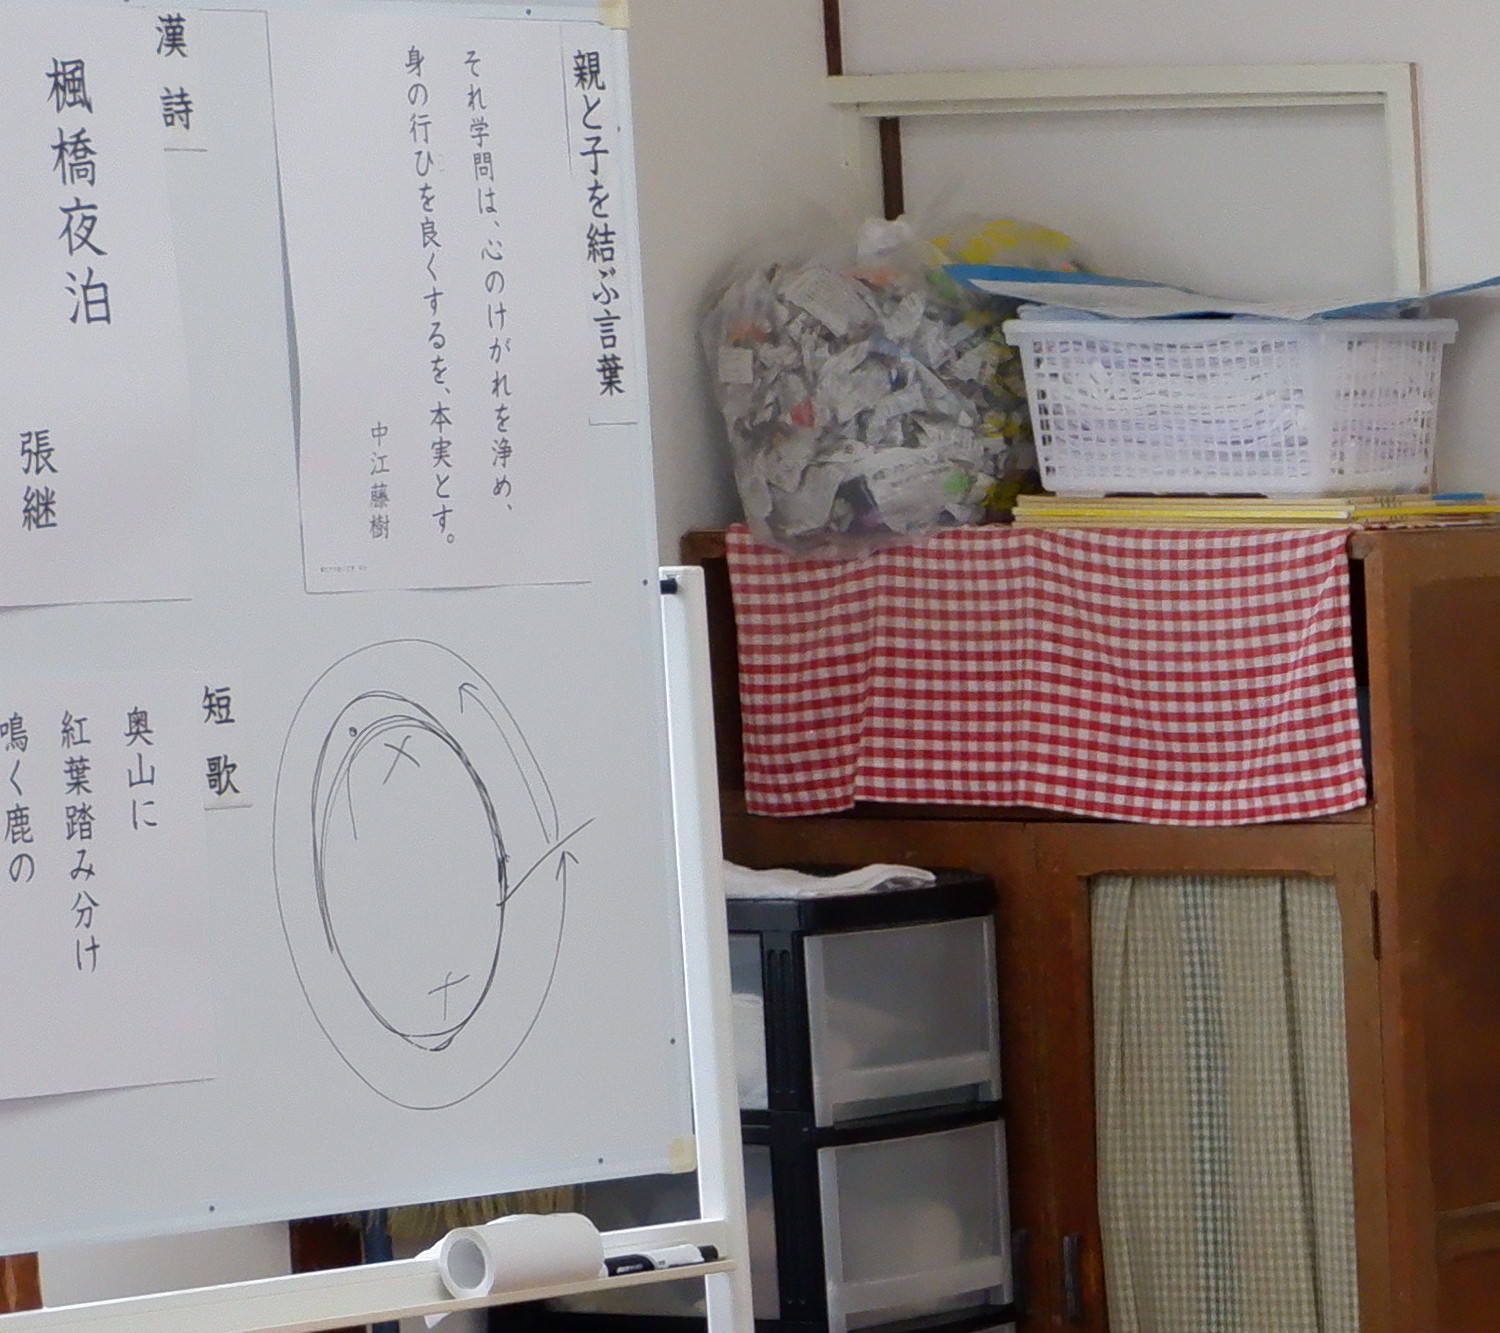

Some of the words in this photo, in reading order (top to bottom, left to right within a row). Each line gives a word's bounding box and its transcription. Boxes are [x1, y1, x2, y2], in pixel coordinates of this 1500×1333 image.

[46, 57, 112, 327] 楓橋夜泊
[464, 50, 513, 511] それ学問は、心のけがれを浄め、
[572, 49, 625, 397] 親と子を結ぶ言葉
[19, 428, 59, 532] 張継
[369, 420, 391, 540] 中江藤樹
[0, 711, 35, 883] 鳴く鹿の
[61, 709, 100, 974] 紅葉踏み分け
[124, 705, 157, 831] 奥山に
